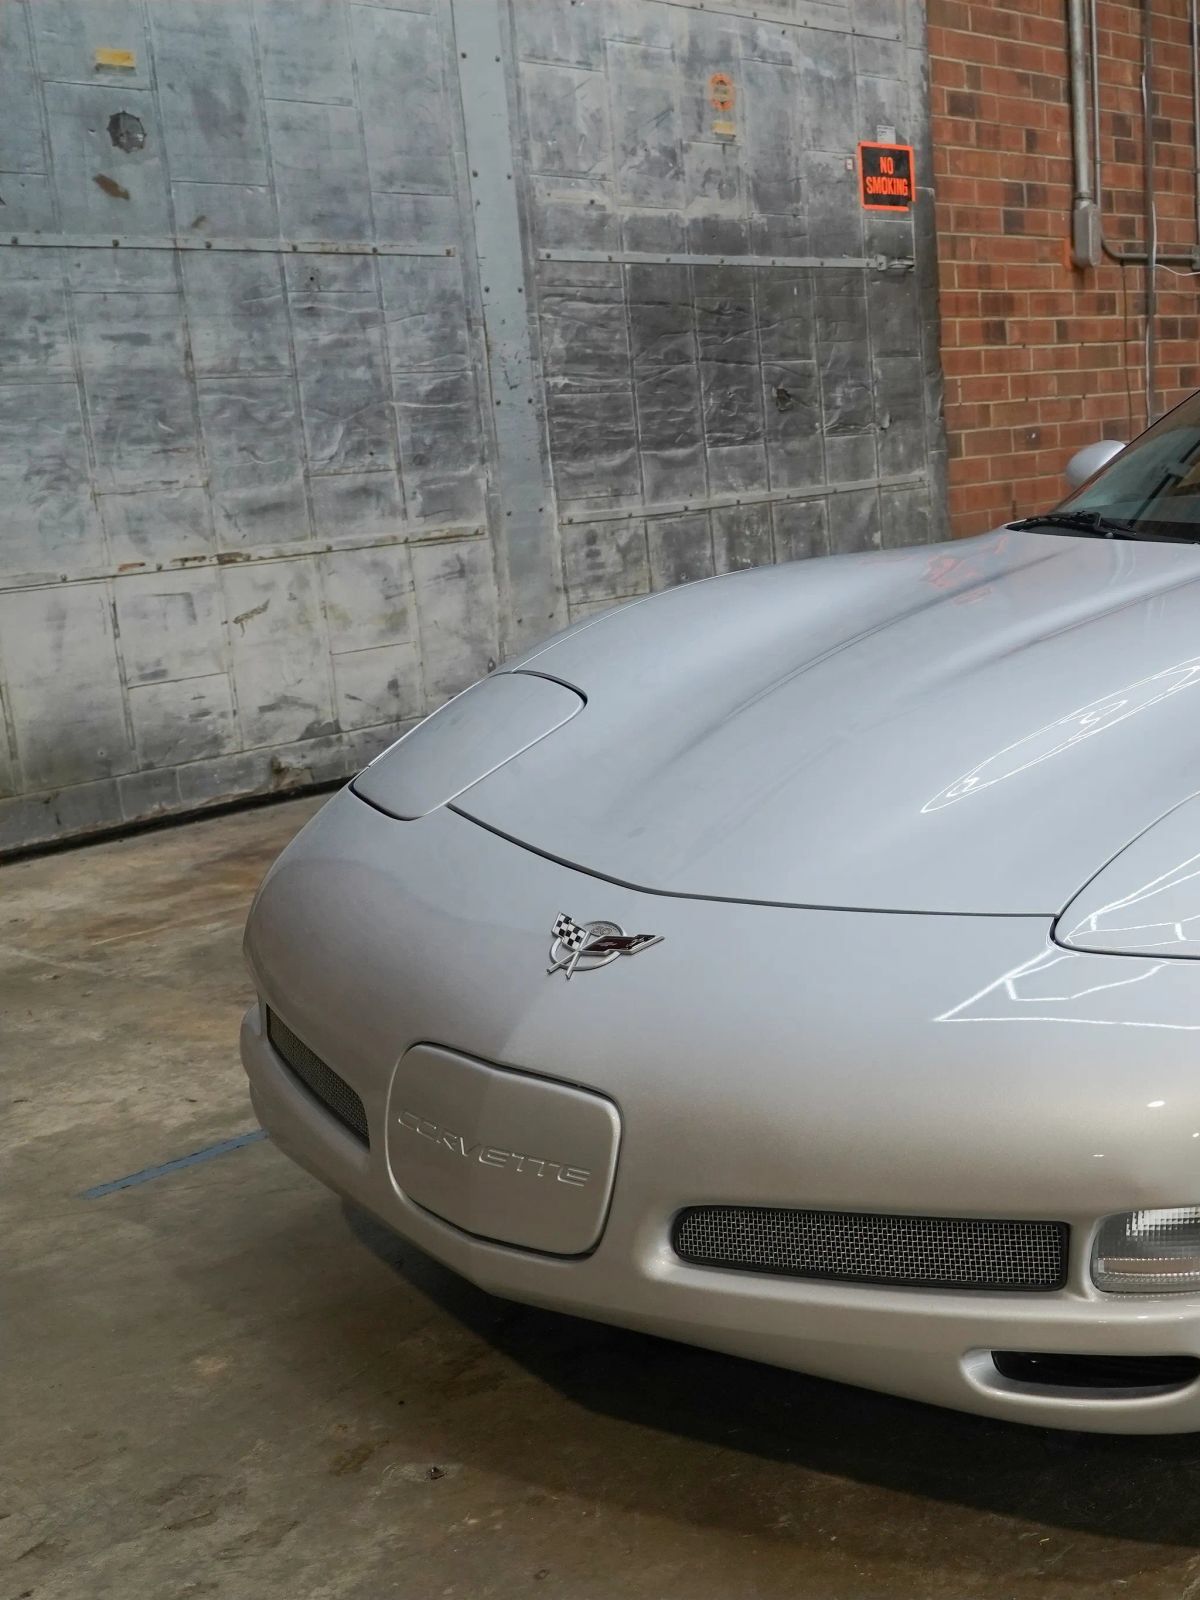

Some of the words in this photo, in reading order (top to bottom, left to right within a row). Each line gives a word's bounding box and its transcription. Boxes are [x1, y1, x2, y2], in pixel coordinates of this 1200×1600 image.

[880, 156, 894, 174] NO
[866, 176, 908, 196] SMOKING
[398, 1111, 591, 1187] CORVETTE
